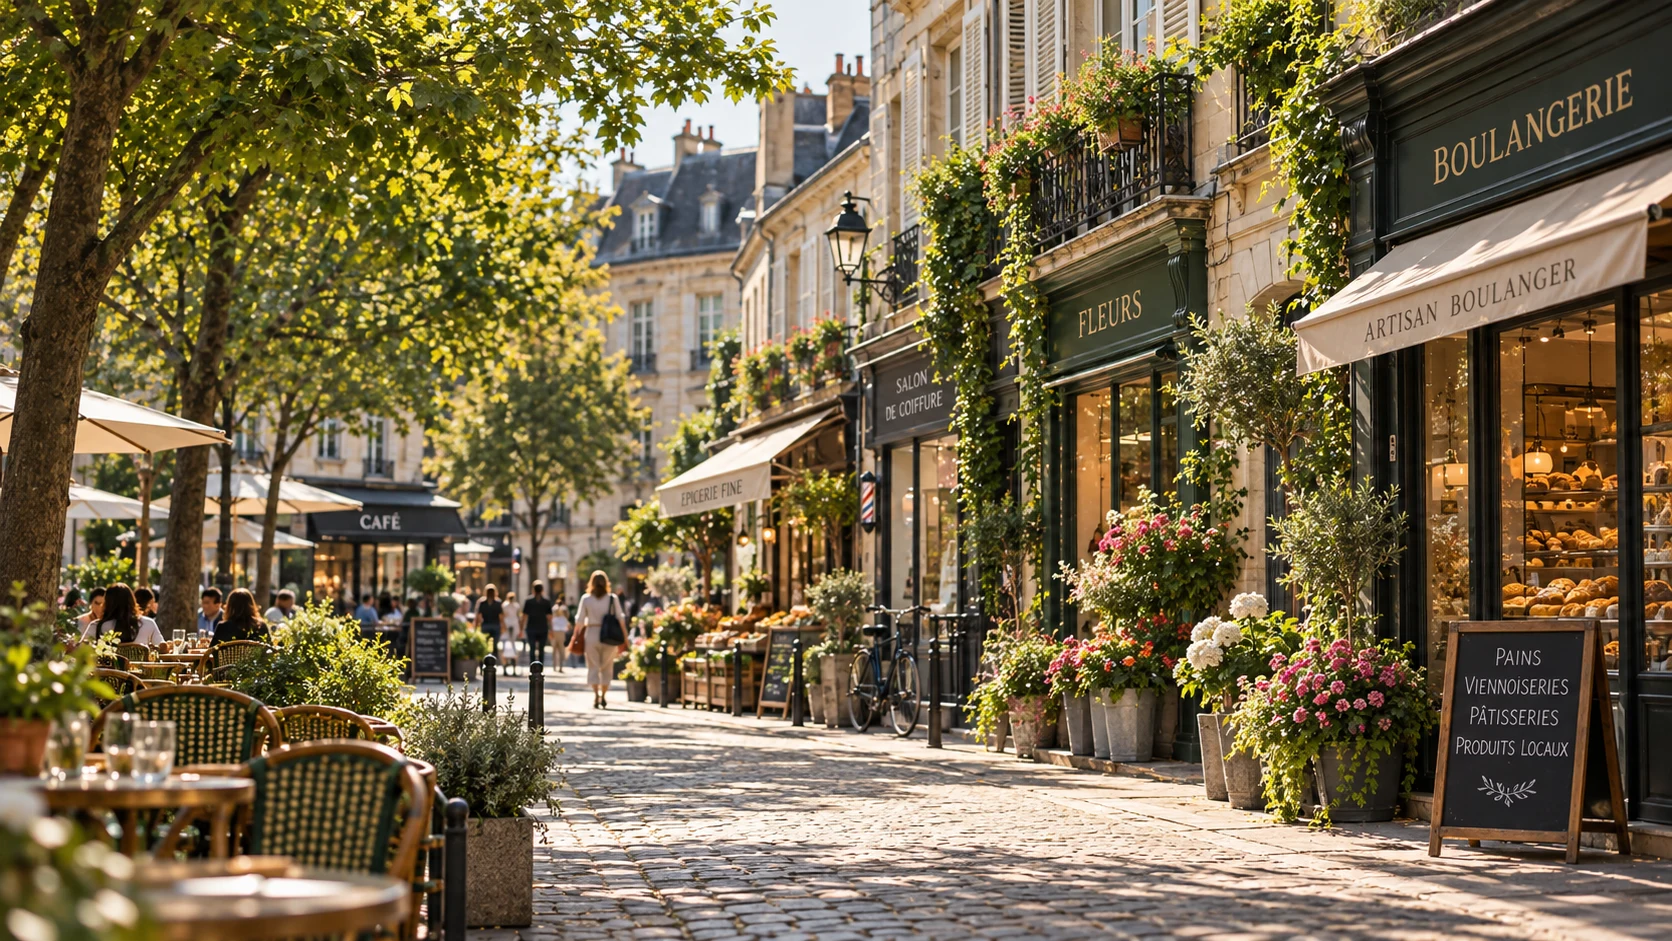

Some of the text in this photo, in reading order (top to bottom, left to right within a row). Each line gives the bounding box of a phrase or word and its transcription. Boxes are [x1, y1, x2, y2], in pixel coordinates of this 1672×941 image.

[1433, 68, 1634, 186] BOULANGERIE
[1363, 257, 1577, 344] ARTISAN BOULANGER
[1078, 289, 1142, 339] FLEURS
[896, 369, 928, 394] SALON
[885, 390, 943, 421] DE COIFFURE
[681, 479, 743, 507] EPICERIE FINE
[359, 512, 401, 530] CAFÉ
[1495, 647, 1542, 666] PAINS
[1469, 704, 1560, 727] PÂTISSERIES
[1455, 736, 1570, 758] PRODUITS LOCAUX
